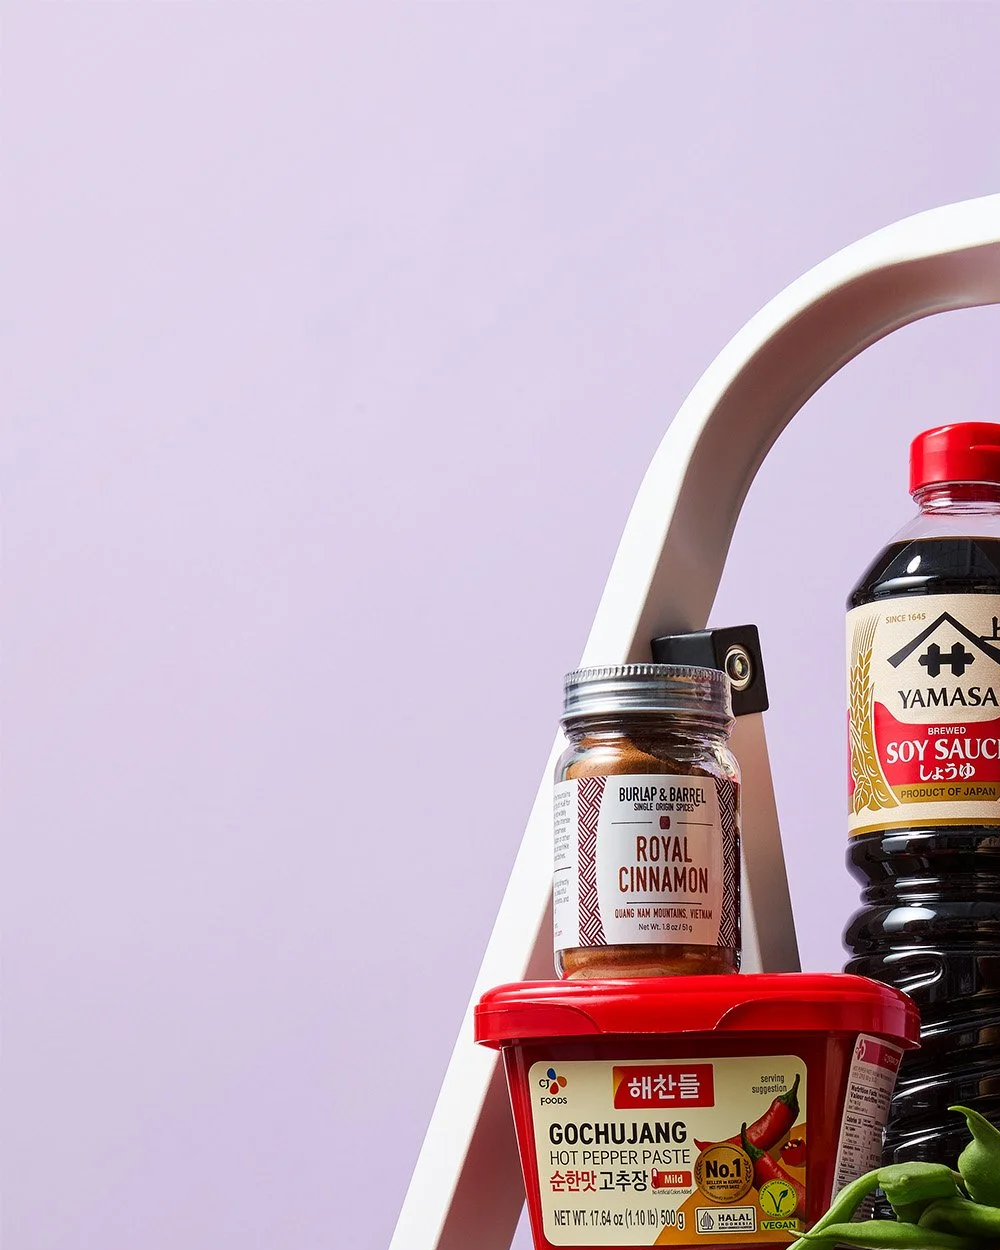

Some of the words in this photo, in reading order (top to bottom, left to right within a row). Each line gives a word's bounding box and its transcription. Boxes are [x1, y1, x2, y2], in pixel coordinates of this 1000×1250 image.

[885, 615, 906, 624] SINCE
[907, 612, 926, 621] 1645
[897, 686, 1000, 709] YAMASA
[927, 726, 967, 736] BREWED
[886, 739, 929, 764] SOY
[919, 762, 976, 781] しょうゆ
[619, 786, 658, 802] BURLAP
[659, 787, 668, 802] &
[669, 786, 707, 807] BARREL
[900, 788, 946, 799] PRODUCT
[947, 787, 962, 797] OF
[963, 787, 996, 797] JAPAN
[633, 802, 654, 812] SINGLE
[655, 802, 675, 812] ORIGIN
[675, 803, 695, 813] SPICES
[635, 835, 693, 863] ROYAL
[618, 866, 709, 894] CINNAMON
[614, 908, 635, 919] QUANG
[636, 908, 651, 919] NAM
[690, 908, 714, 920] VIETNAM
[638, 923, 650, 931] Net
[538, 1079, 550, 1090] CJ
[760, 1074, 785, 1085] serving
[627, 1073, 700, 1100] 해찬들
[751, 1084, 788, 1095] suggestion
[540, 1097, 568, 1106] FOODS
[549, 1121, 687, 1145] GOCHUJANG
[549, 1150, 579, 1166] HOT
[582, 1150, 638, 1166] PEPPER
[642, 1149, 691, 1165] PASTE
[705, 1158, 741, 1179] No.1
[549, 1170, 597, 1192] 순한맛
[599, 1170, 649, 1192] 고추장
[664, 1174, 683, 1184] Mild
[554, 1209, 571, 1226] NET
[572, 1209, 588, 1226] WT.
[589, 1209, 612, 1226] 17.64
[613, 1214, 624, 1226] oz
[625, 1208, 646, 1229] (1.10
[647, 1208, 659, 1229] lb)
[660, 1209, 676, 1226] 500
[677, 1213, 685, 1230] g
[718, 1213, 752, 1222] HALAL
[762, 1220, 796, 1230] VEGAN
